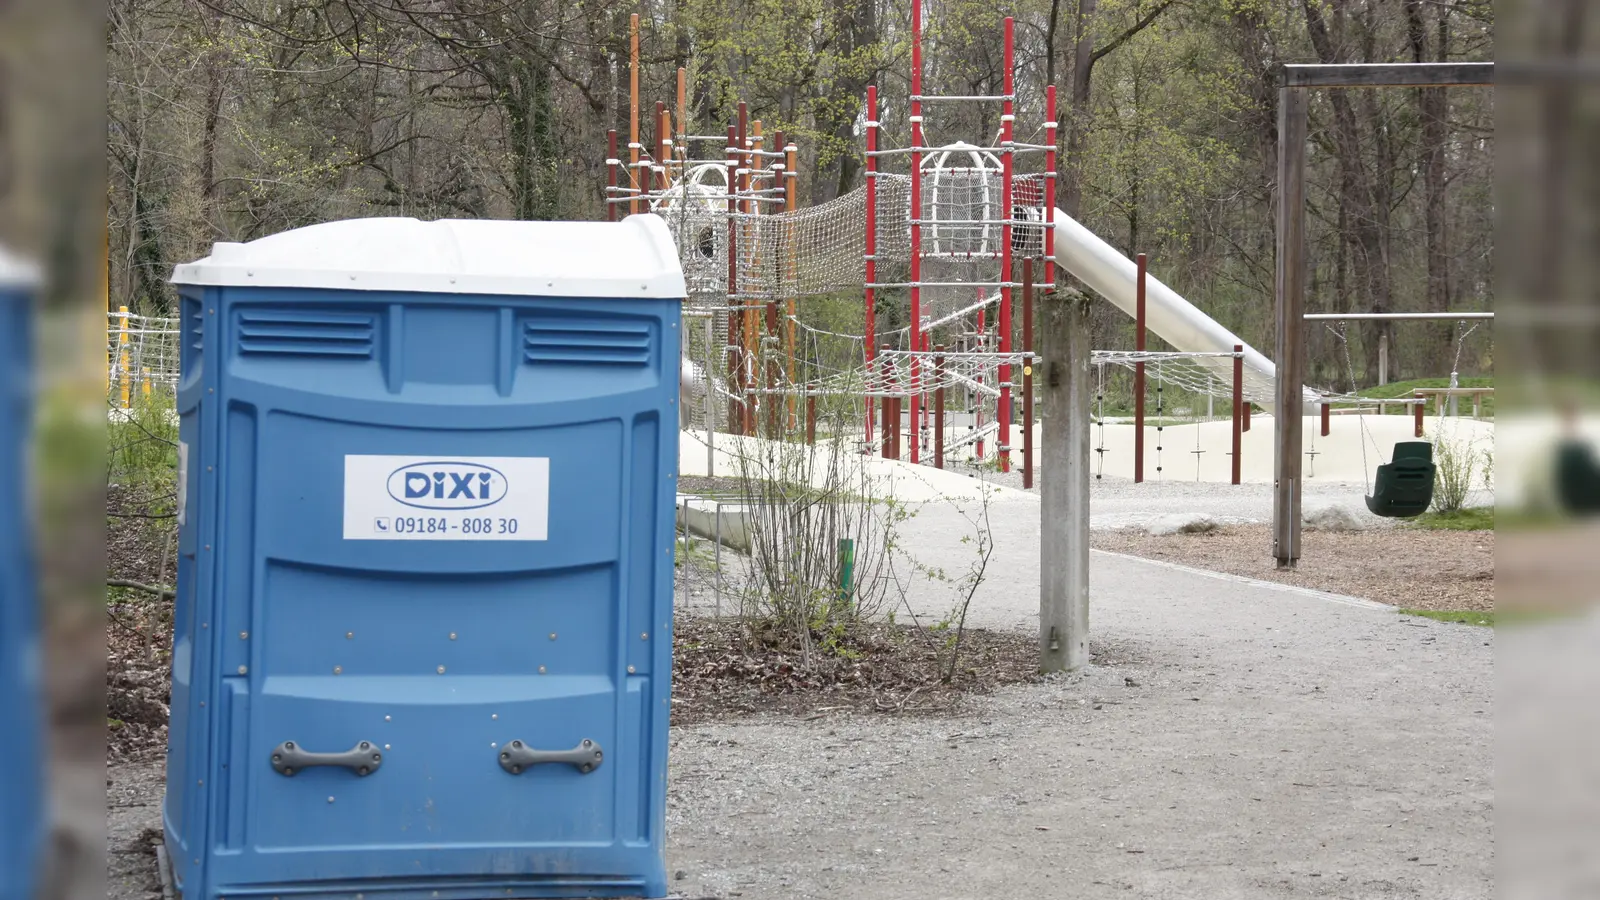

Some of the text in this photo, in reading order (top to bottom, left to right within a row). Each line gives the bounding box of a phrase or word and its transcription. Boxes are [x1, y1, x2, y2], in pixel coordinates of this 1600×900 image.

[395, 517, 447, 533] 09184
[462, 518, 492, 534] 808
[498, 518, 518, 534] 30
